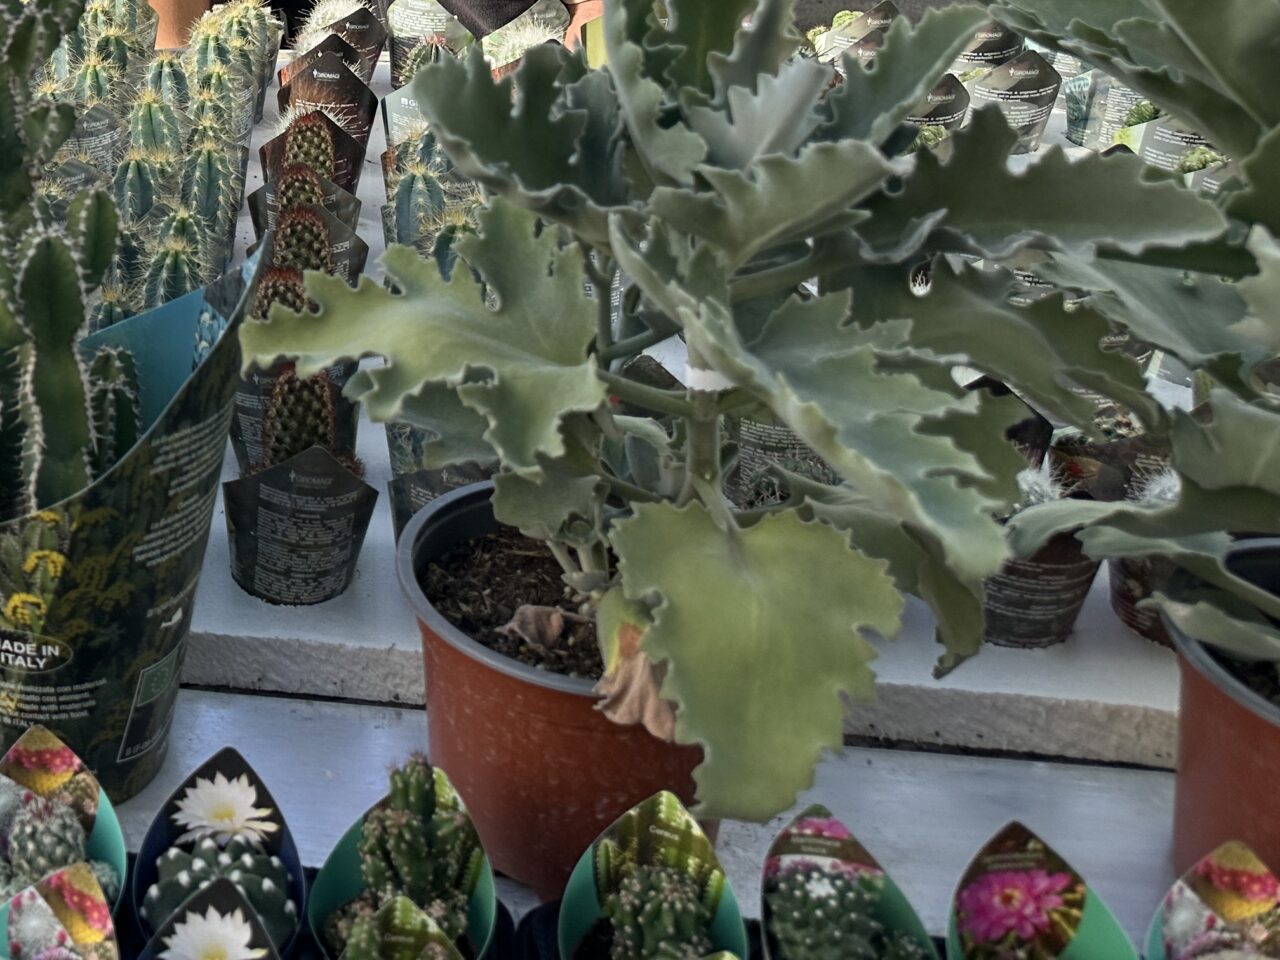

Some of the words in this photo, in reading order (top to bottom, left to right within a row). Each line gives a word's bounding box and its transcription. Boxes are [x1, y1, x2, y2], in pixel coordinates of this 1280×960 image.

[42, 644, 60, 657] IN
[0, 652, 47, 669] ITALY
[648, 824, 680, 841] Cereus
